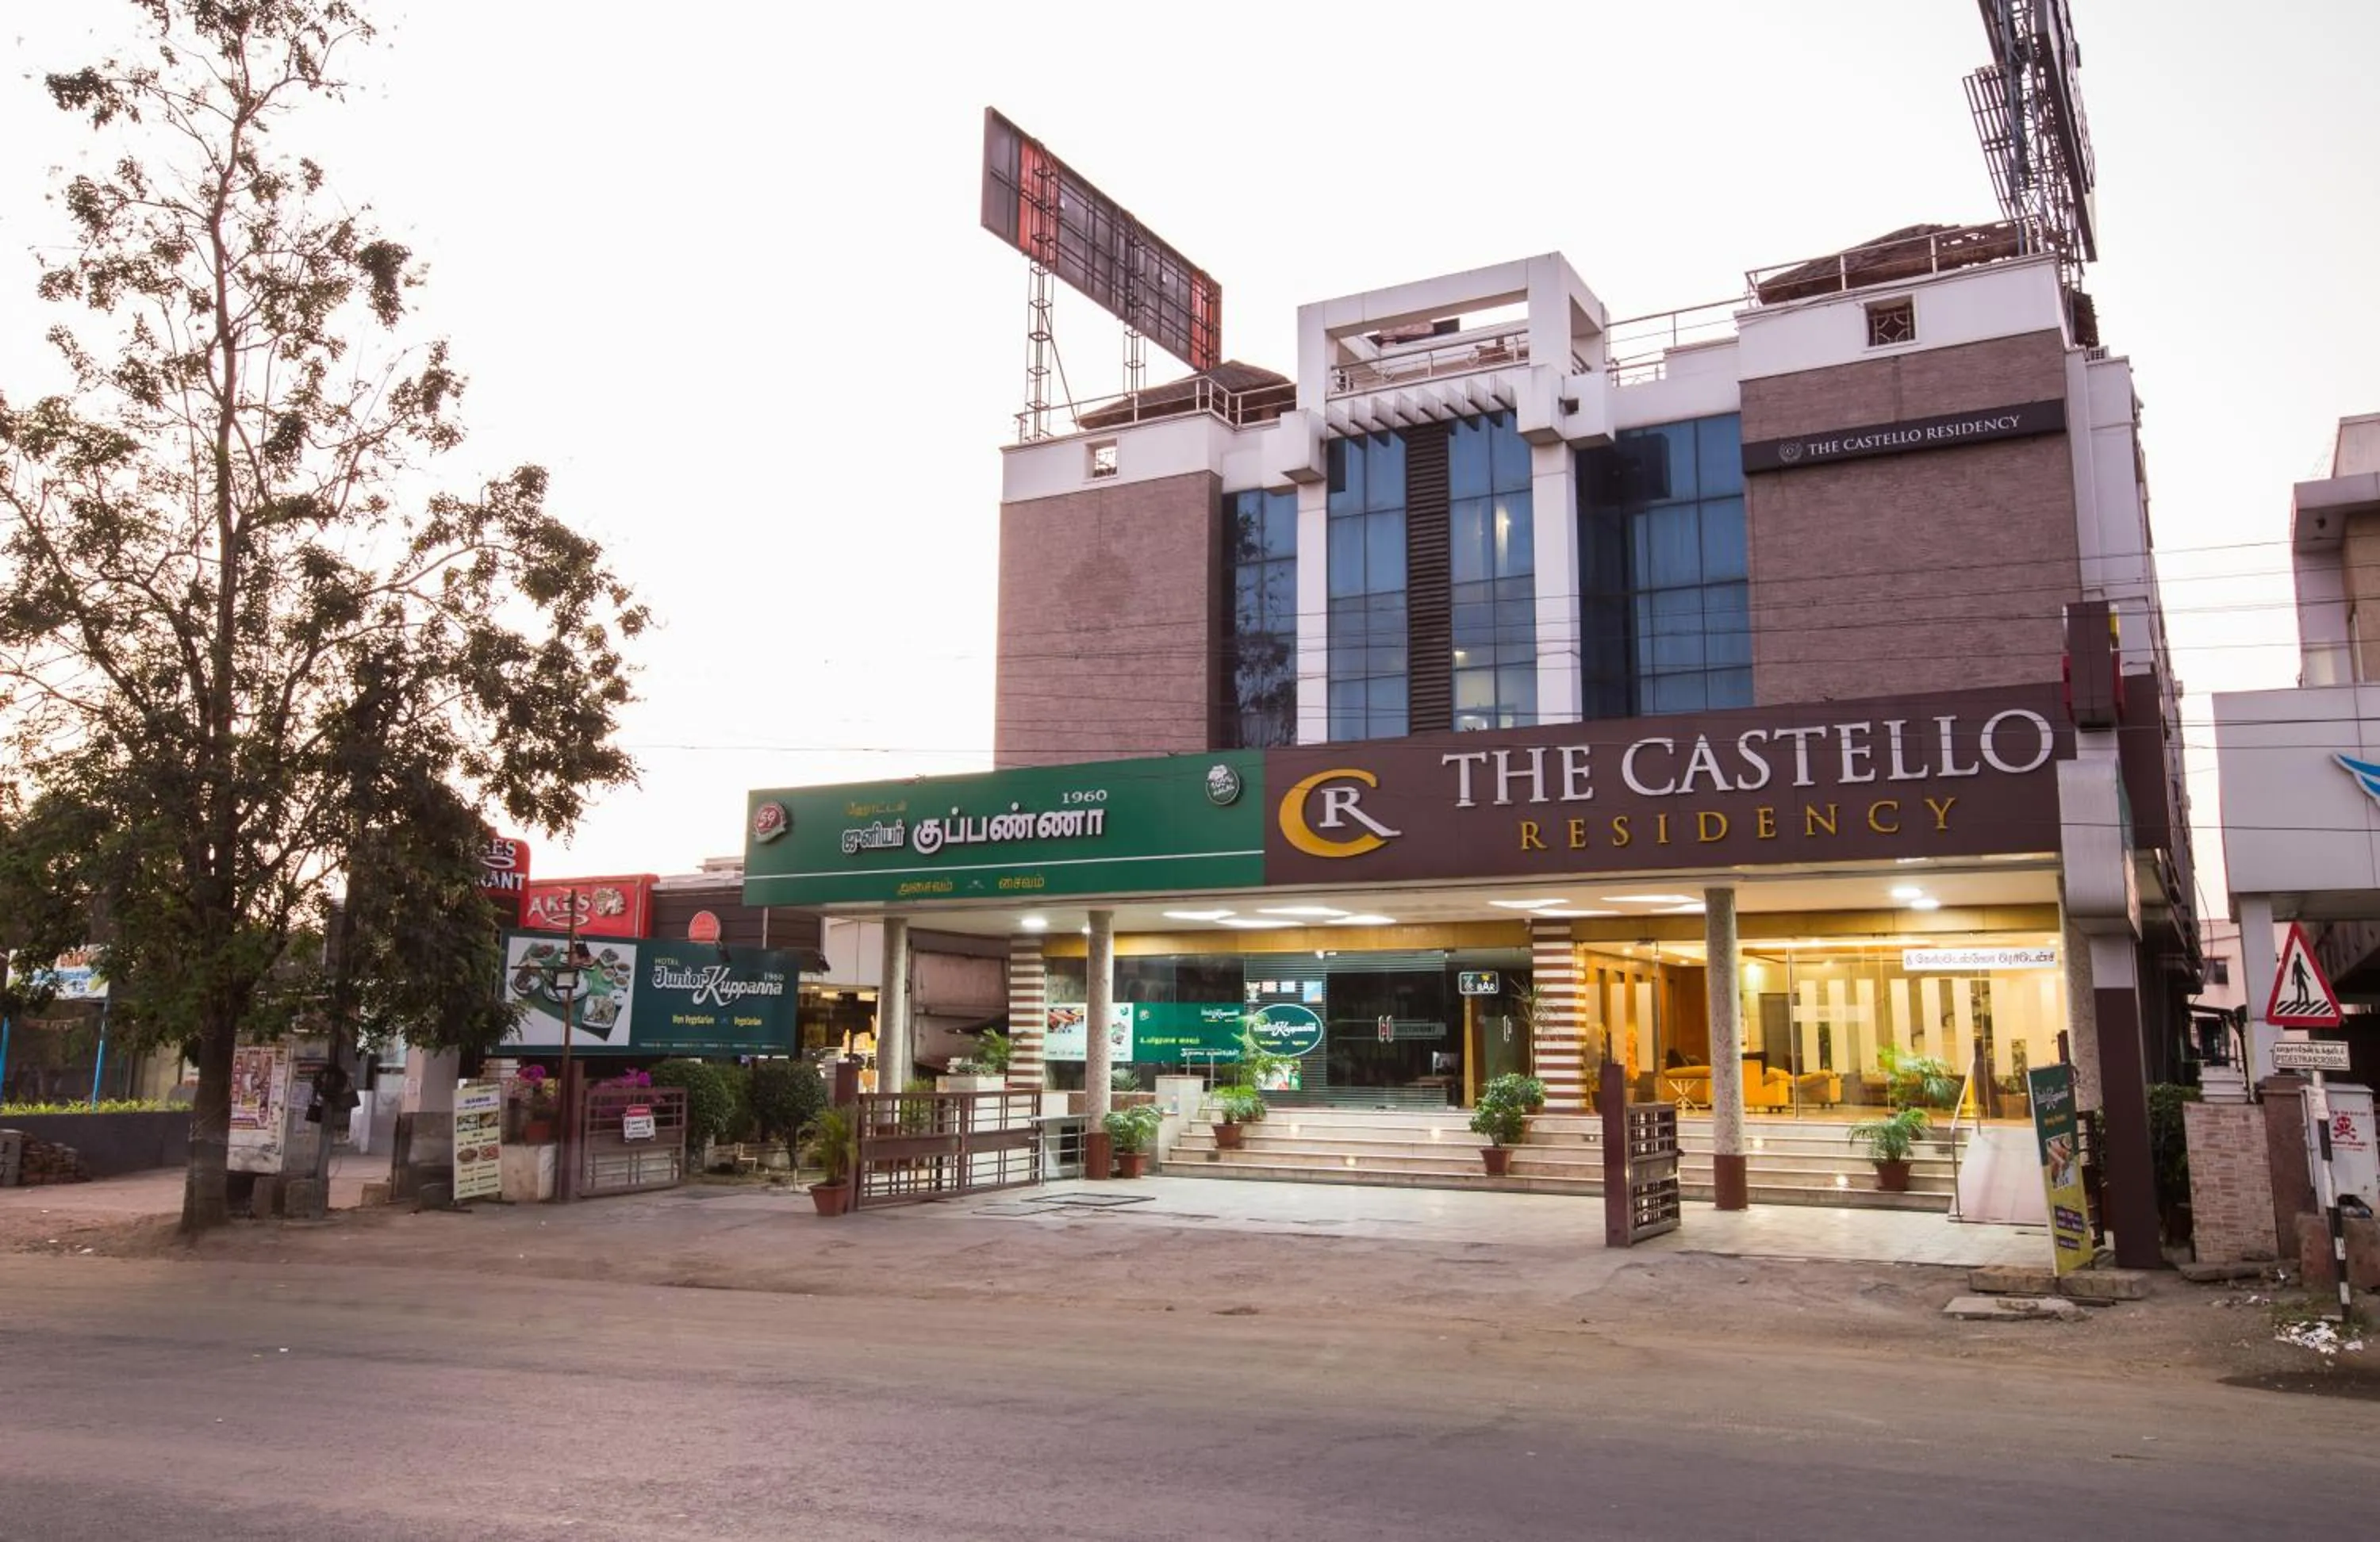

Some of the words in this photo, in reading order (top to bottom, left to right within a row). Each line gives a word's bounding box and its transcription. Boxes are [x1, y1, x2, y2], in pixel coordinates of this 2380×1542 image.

[1807, 441, 1839, 456] THE
[1844, 428, 1921, 452] CASTELLO
[1926, 415, 2021, 440] RESIDENCY
[1442, 744, 1595, 807] THE
[1621, 708, 2053, 796] CASTELLO
[1061, 790, 1107, 804] 1960
[1519, 797, 1958, 851] RESIDENCY
[654, 957, 679, 966] HOTEL
[652, 965, 708, 989] Junior
[693, 965, 783, 1007] Kuppanna
